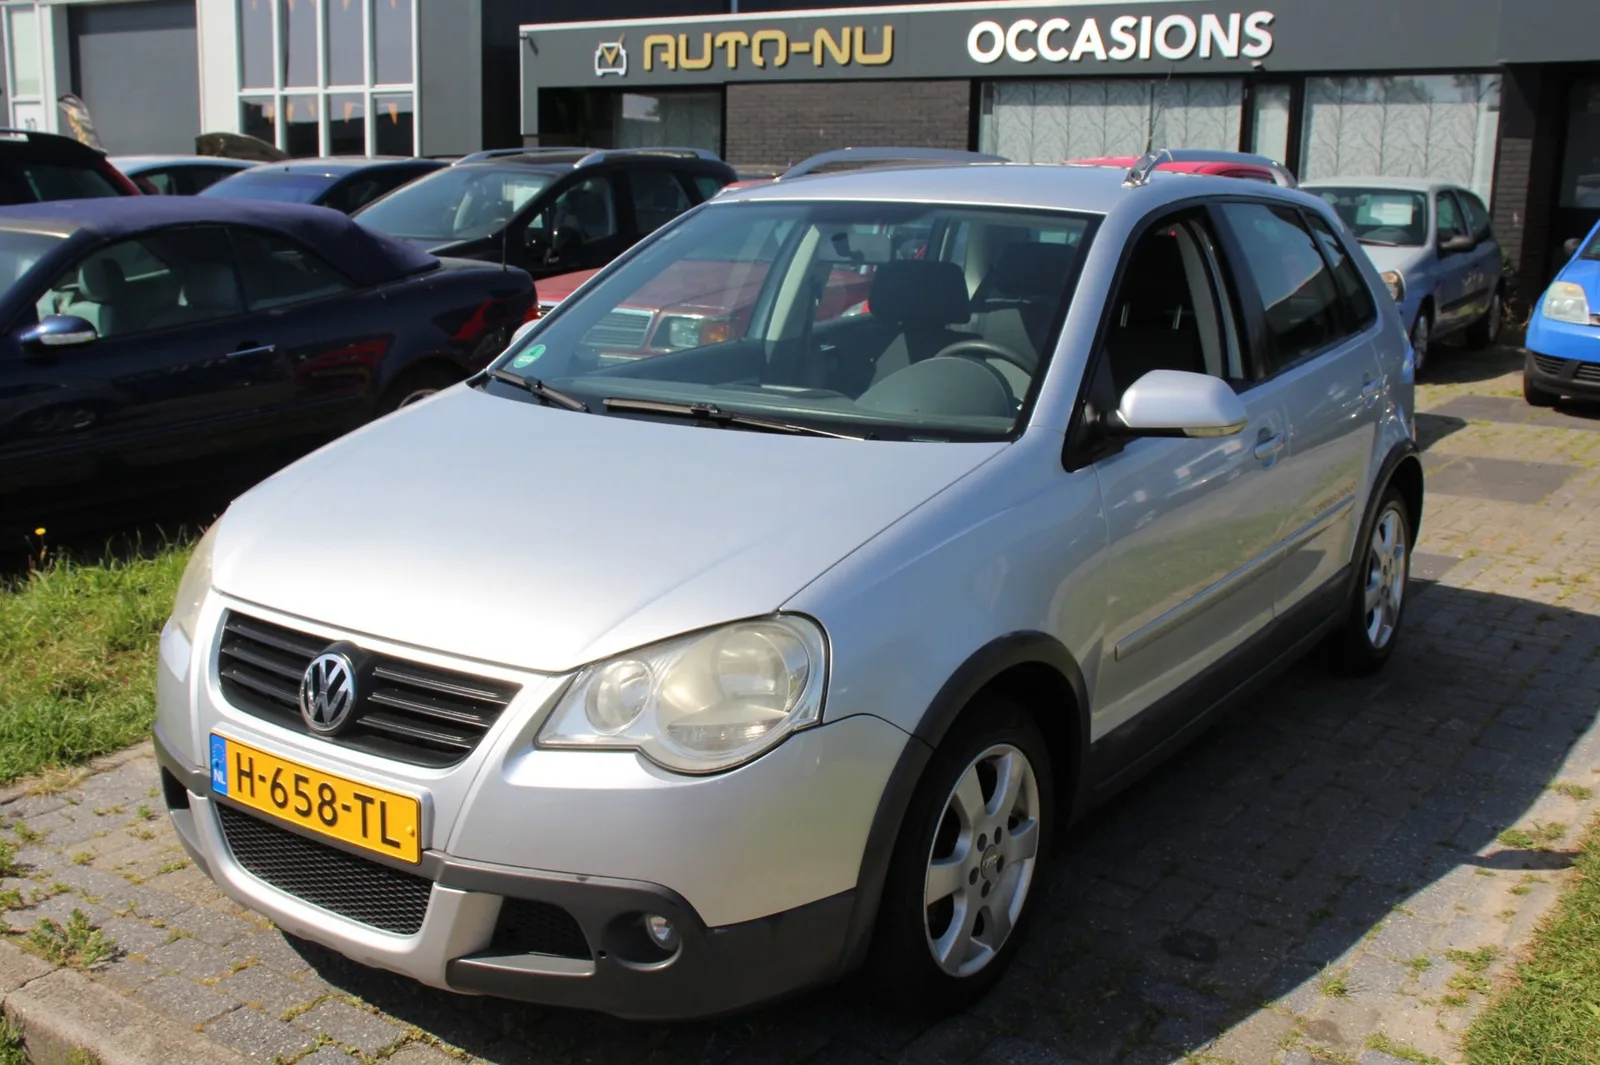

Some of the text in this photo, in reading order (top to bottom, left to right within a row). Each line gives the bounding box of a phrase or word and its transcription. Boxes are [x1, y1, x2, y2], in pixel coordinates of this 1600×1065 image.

[643, 25, 893, 70] AUTO-NU
[967, 11, 1275, 63] OCCASIONS
[213, 769, 226, 785] NL
[236, 752, 401, 849] H-658-TL
